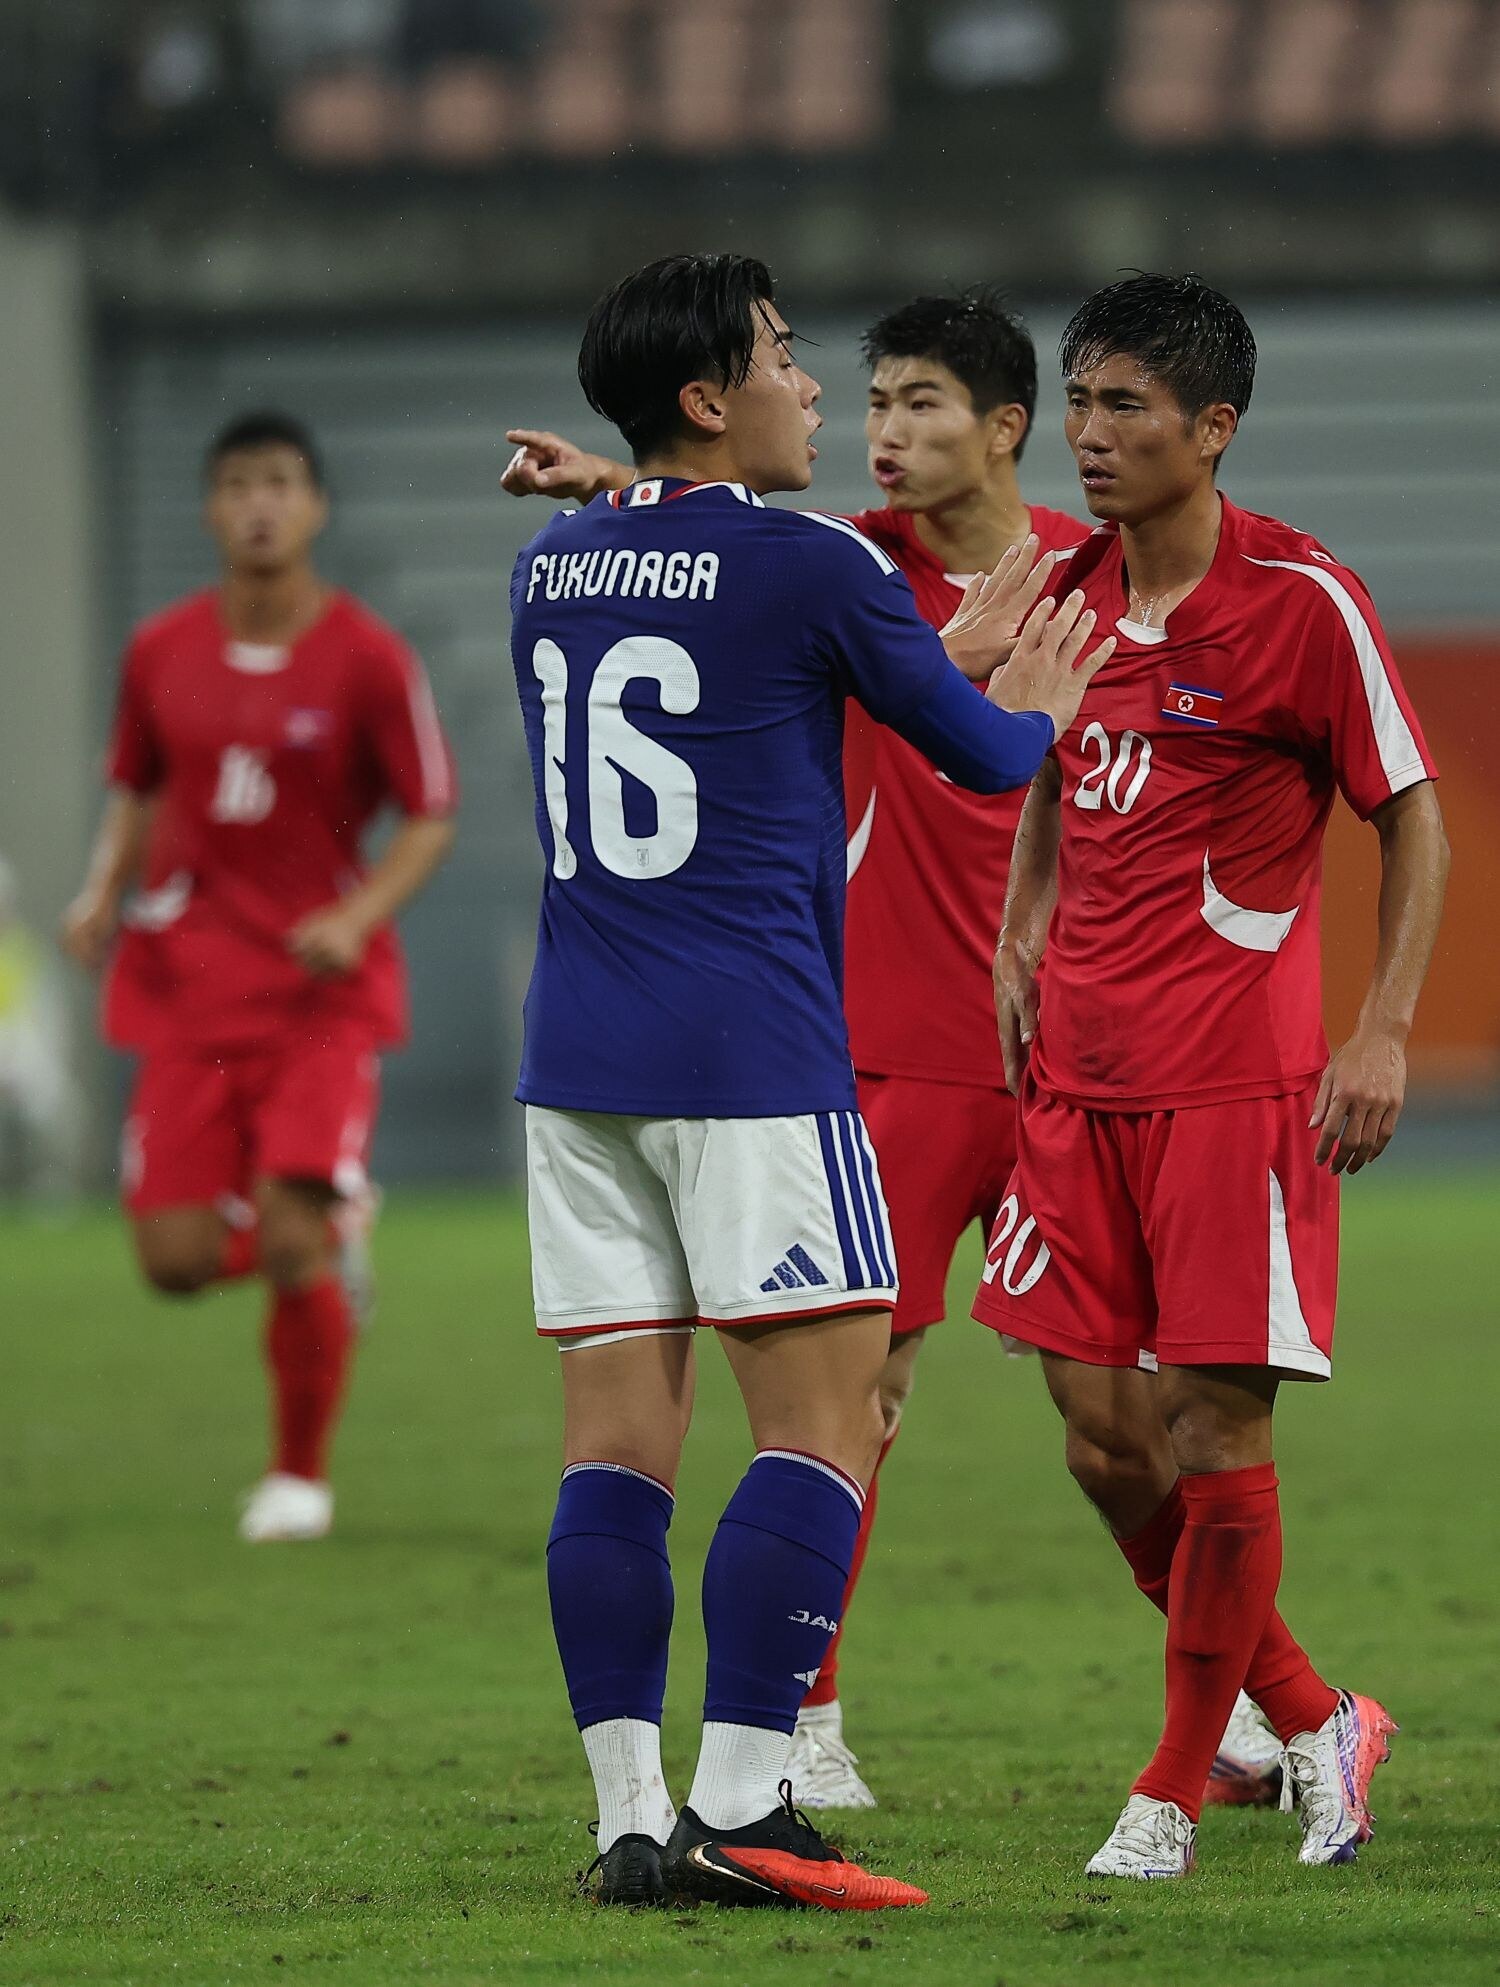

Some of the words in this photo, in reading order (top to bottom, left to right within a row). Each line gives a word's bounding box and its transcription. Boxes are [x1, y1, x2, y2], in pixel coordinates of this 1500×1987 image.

[526, 548, 720, 604] FUKUNAGA
[532, 635, 700, 880] 16
[1073, 721, 1153, 815] 20
[981, 1193, 1051, 1296] 20
